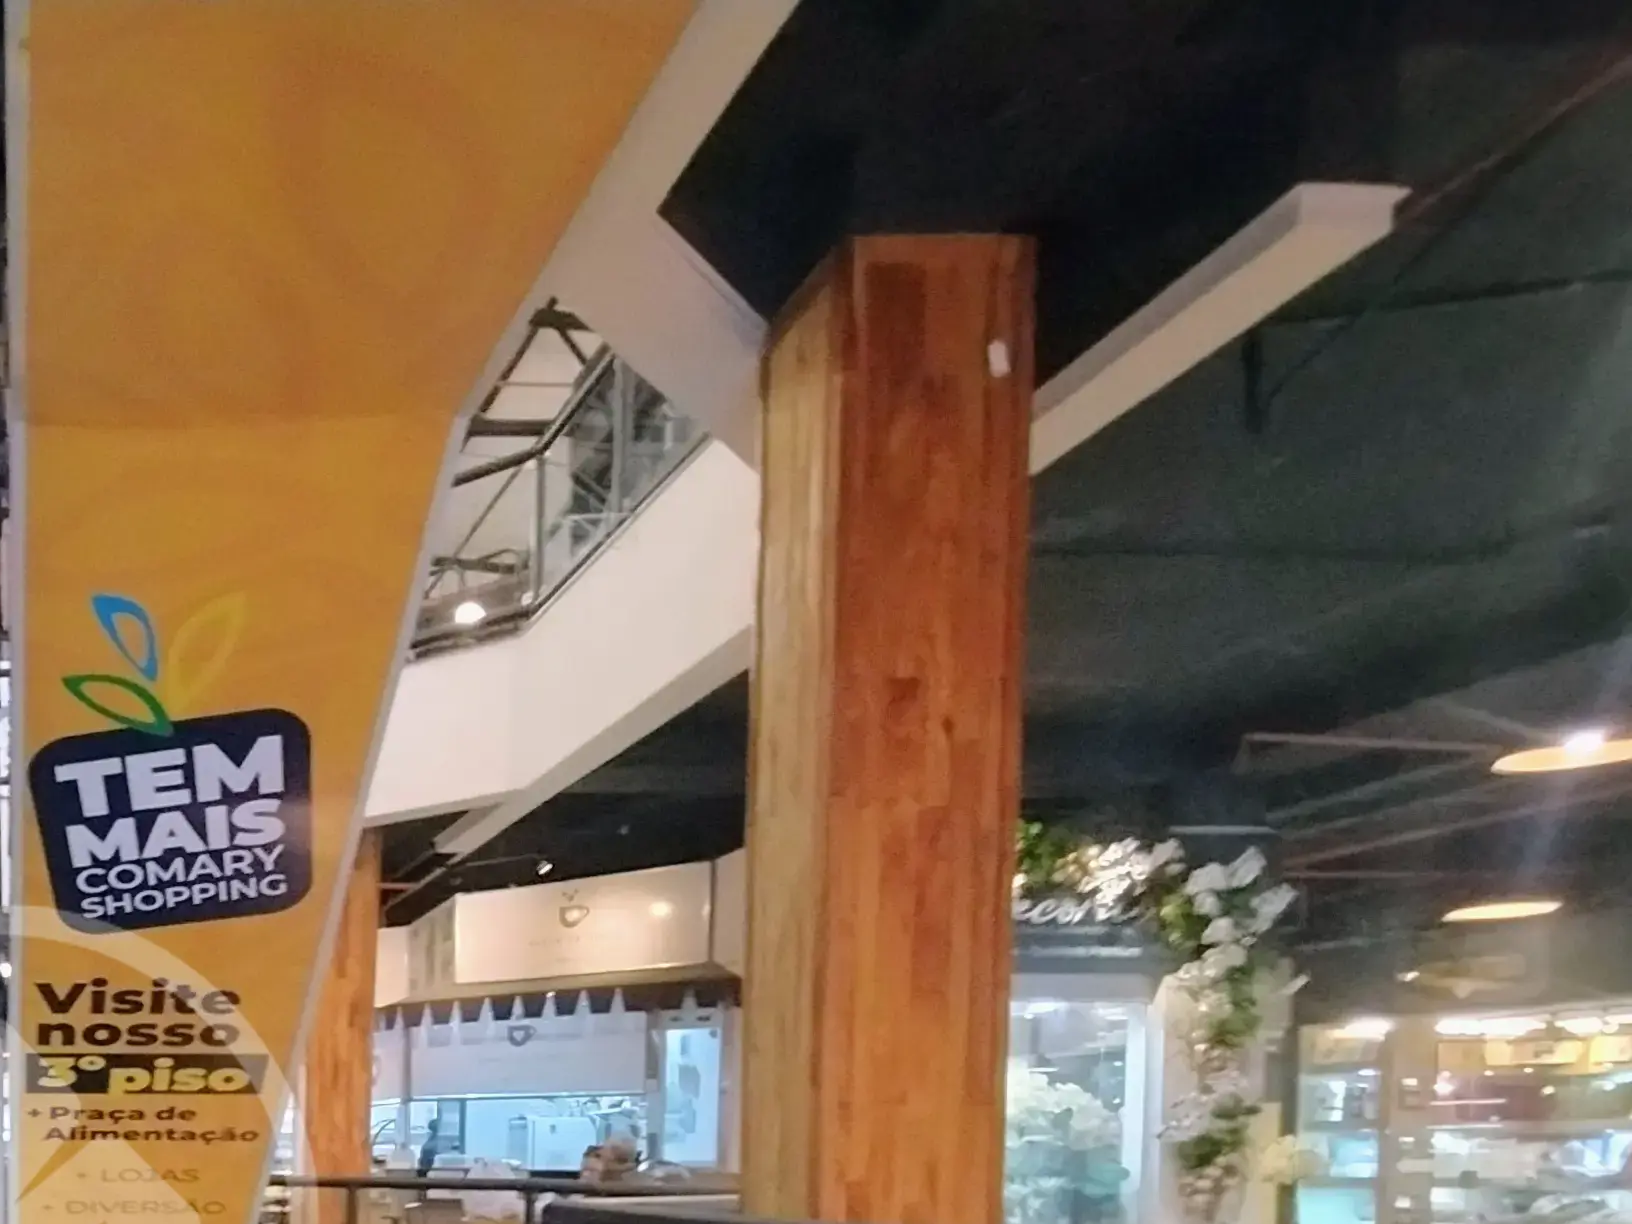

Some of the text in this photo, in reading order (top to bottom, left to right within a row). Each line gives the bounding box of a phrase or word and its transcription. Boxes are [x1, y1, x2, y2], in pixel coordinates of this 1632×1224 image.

[54, 735, 285, 818] TEM
[65, 798, 286, 868] MAIS
[76, 844, 285, 894] COMARY
[80, 874, 288, 919] SHOPPING
[34, 978, 241, 1014] Visite
[37, 1022, 240, 1047] nosso
[108, 1057, 251, 1095] piso
[49, 1106, 145, 1124] Praça
[155, 1106, 197, 1121] de
[44, 1126, 260, 1145] Alimentação
[100, 1168, 201, 1183] LOJAS
